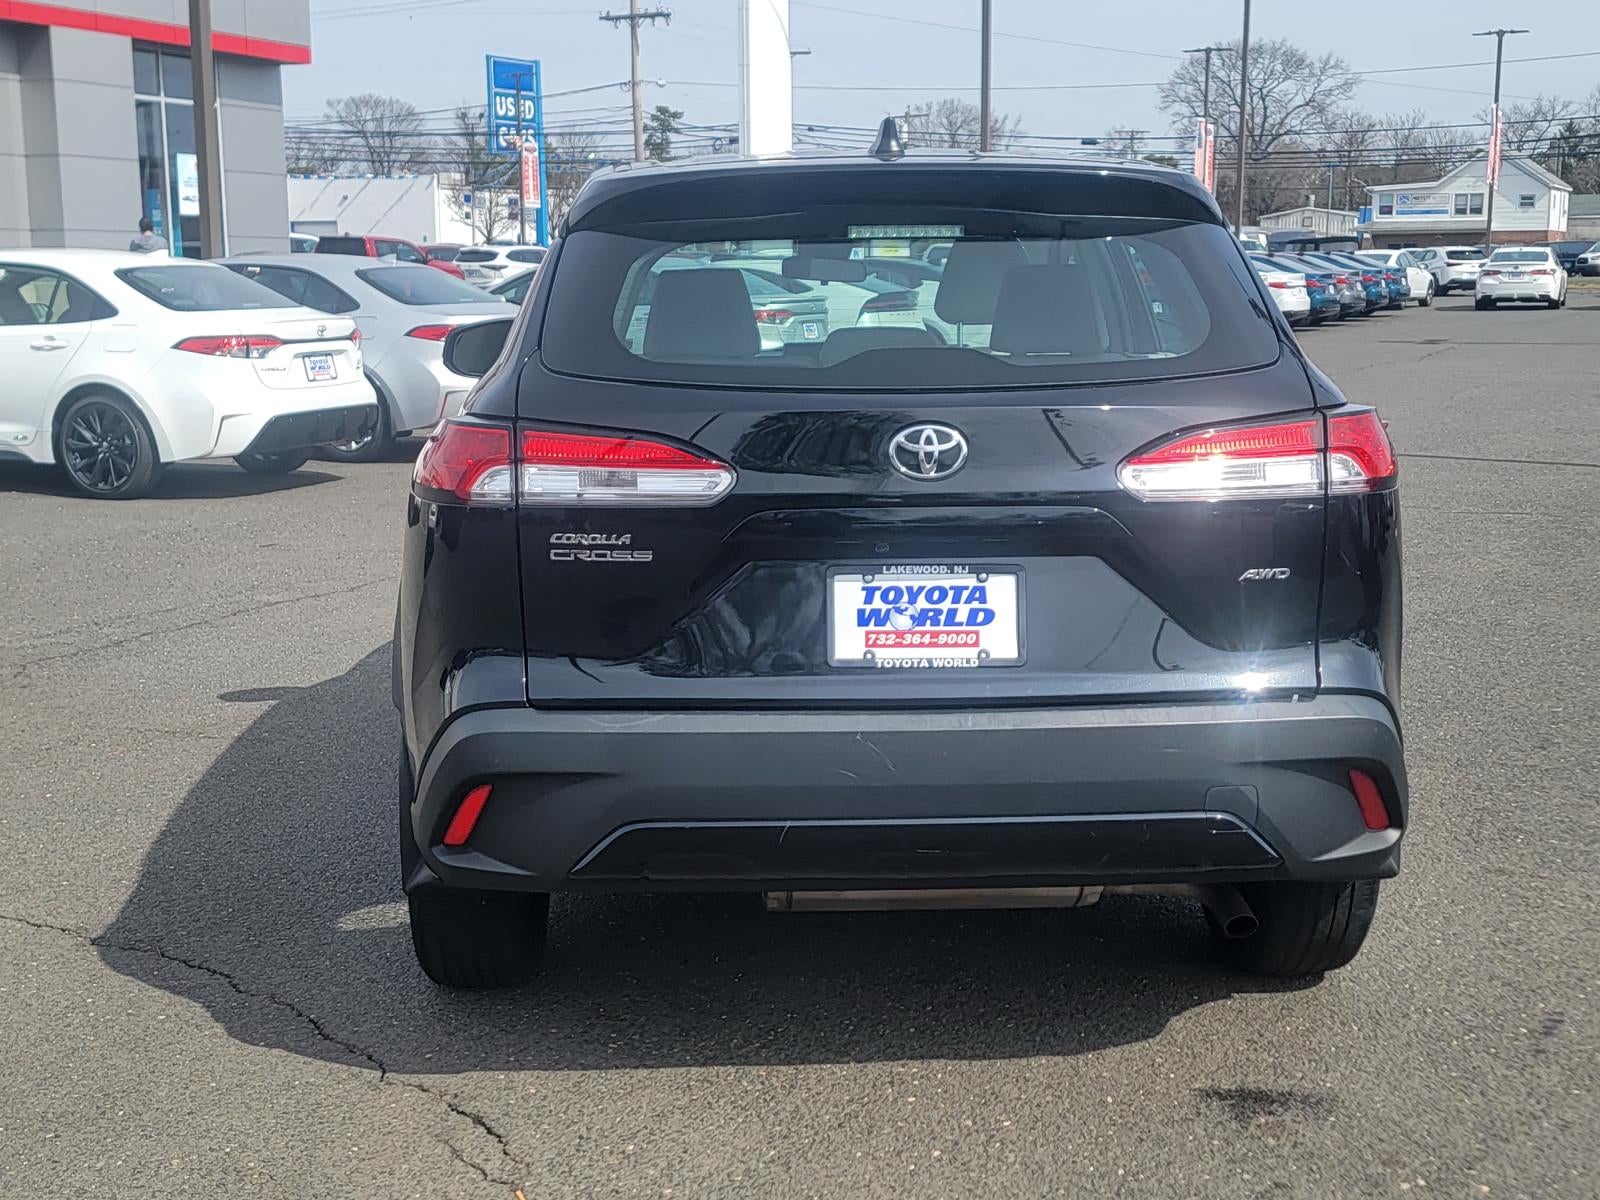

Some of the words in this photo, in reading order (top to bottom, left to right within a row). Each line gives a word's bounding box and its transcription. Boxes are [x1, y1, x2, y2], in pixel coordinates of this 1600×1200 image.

[550, 533, 632, 545] COROLLA
[550, 549, 653, 561] CROSS
[953, 565, 969, 574] NJ
[1238, 567, 1291, 581] AWD
[861, 585, 988, 605] TOYOTA
[867, 633, 977, 645] 732-364-9000
[875, 658, 929, 667] TOYOTA
[932, 658, 979, 667] WORLD
